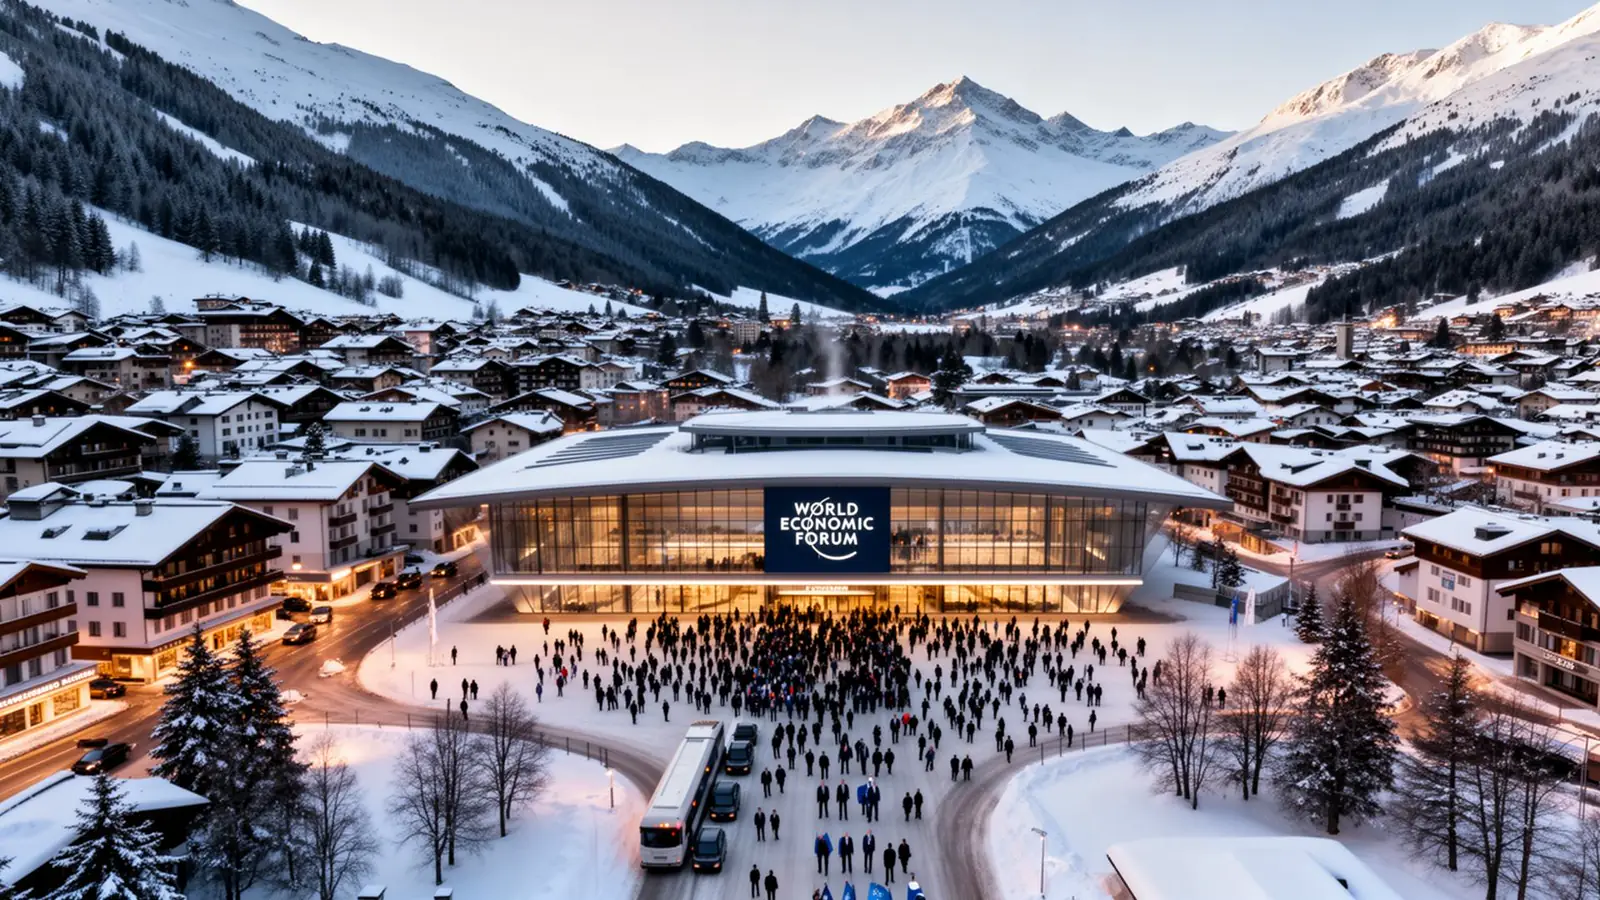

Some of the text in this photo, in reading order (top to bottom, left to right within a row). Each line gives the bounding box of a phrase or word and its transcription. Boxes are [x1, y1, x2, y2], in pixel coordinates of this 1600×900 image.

[794, 502, 859, 516] WORLD
[780, 517, 874, 531] ECONOMIC
[795, 532, 858, 546] FORUM
